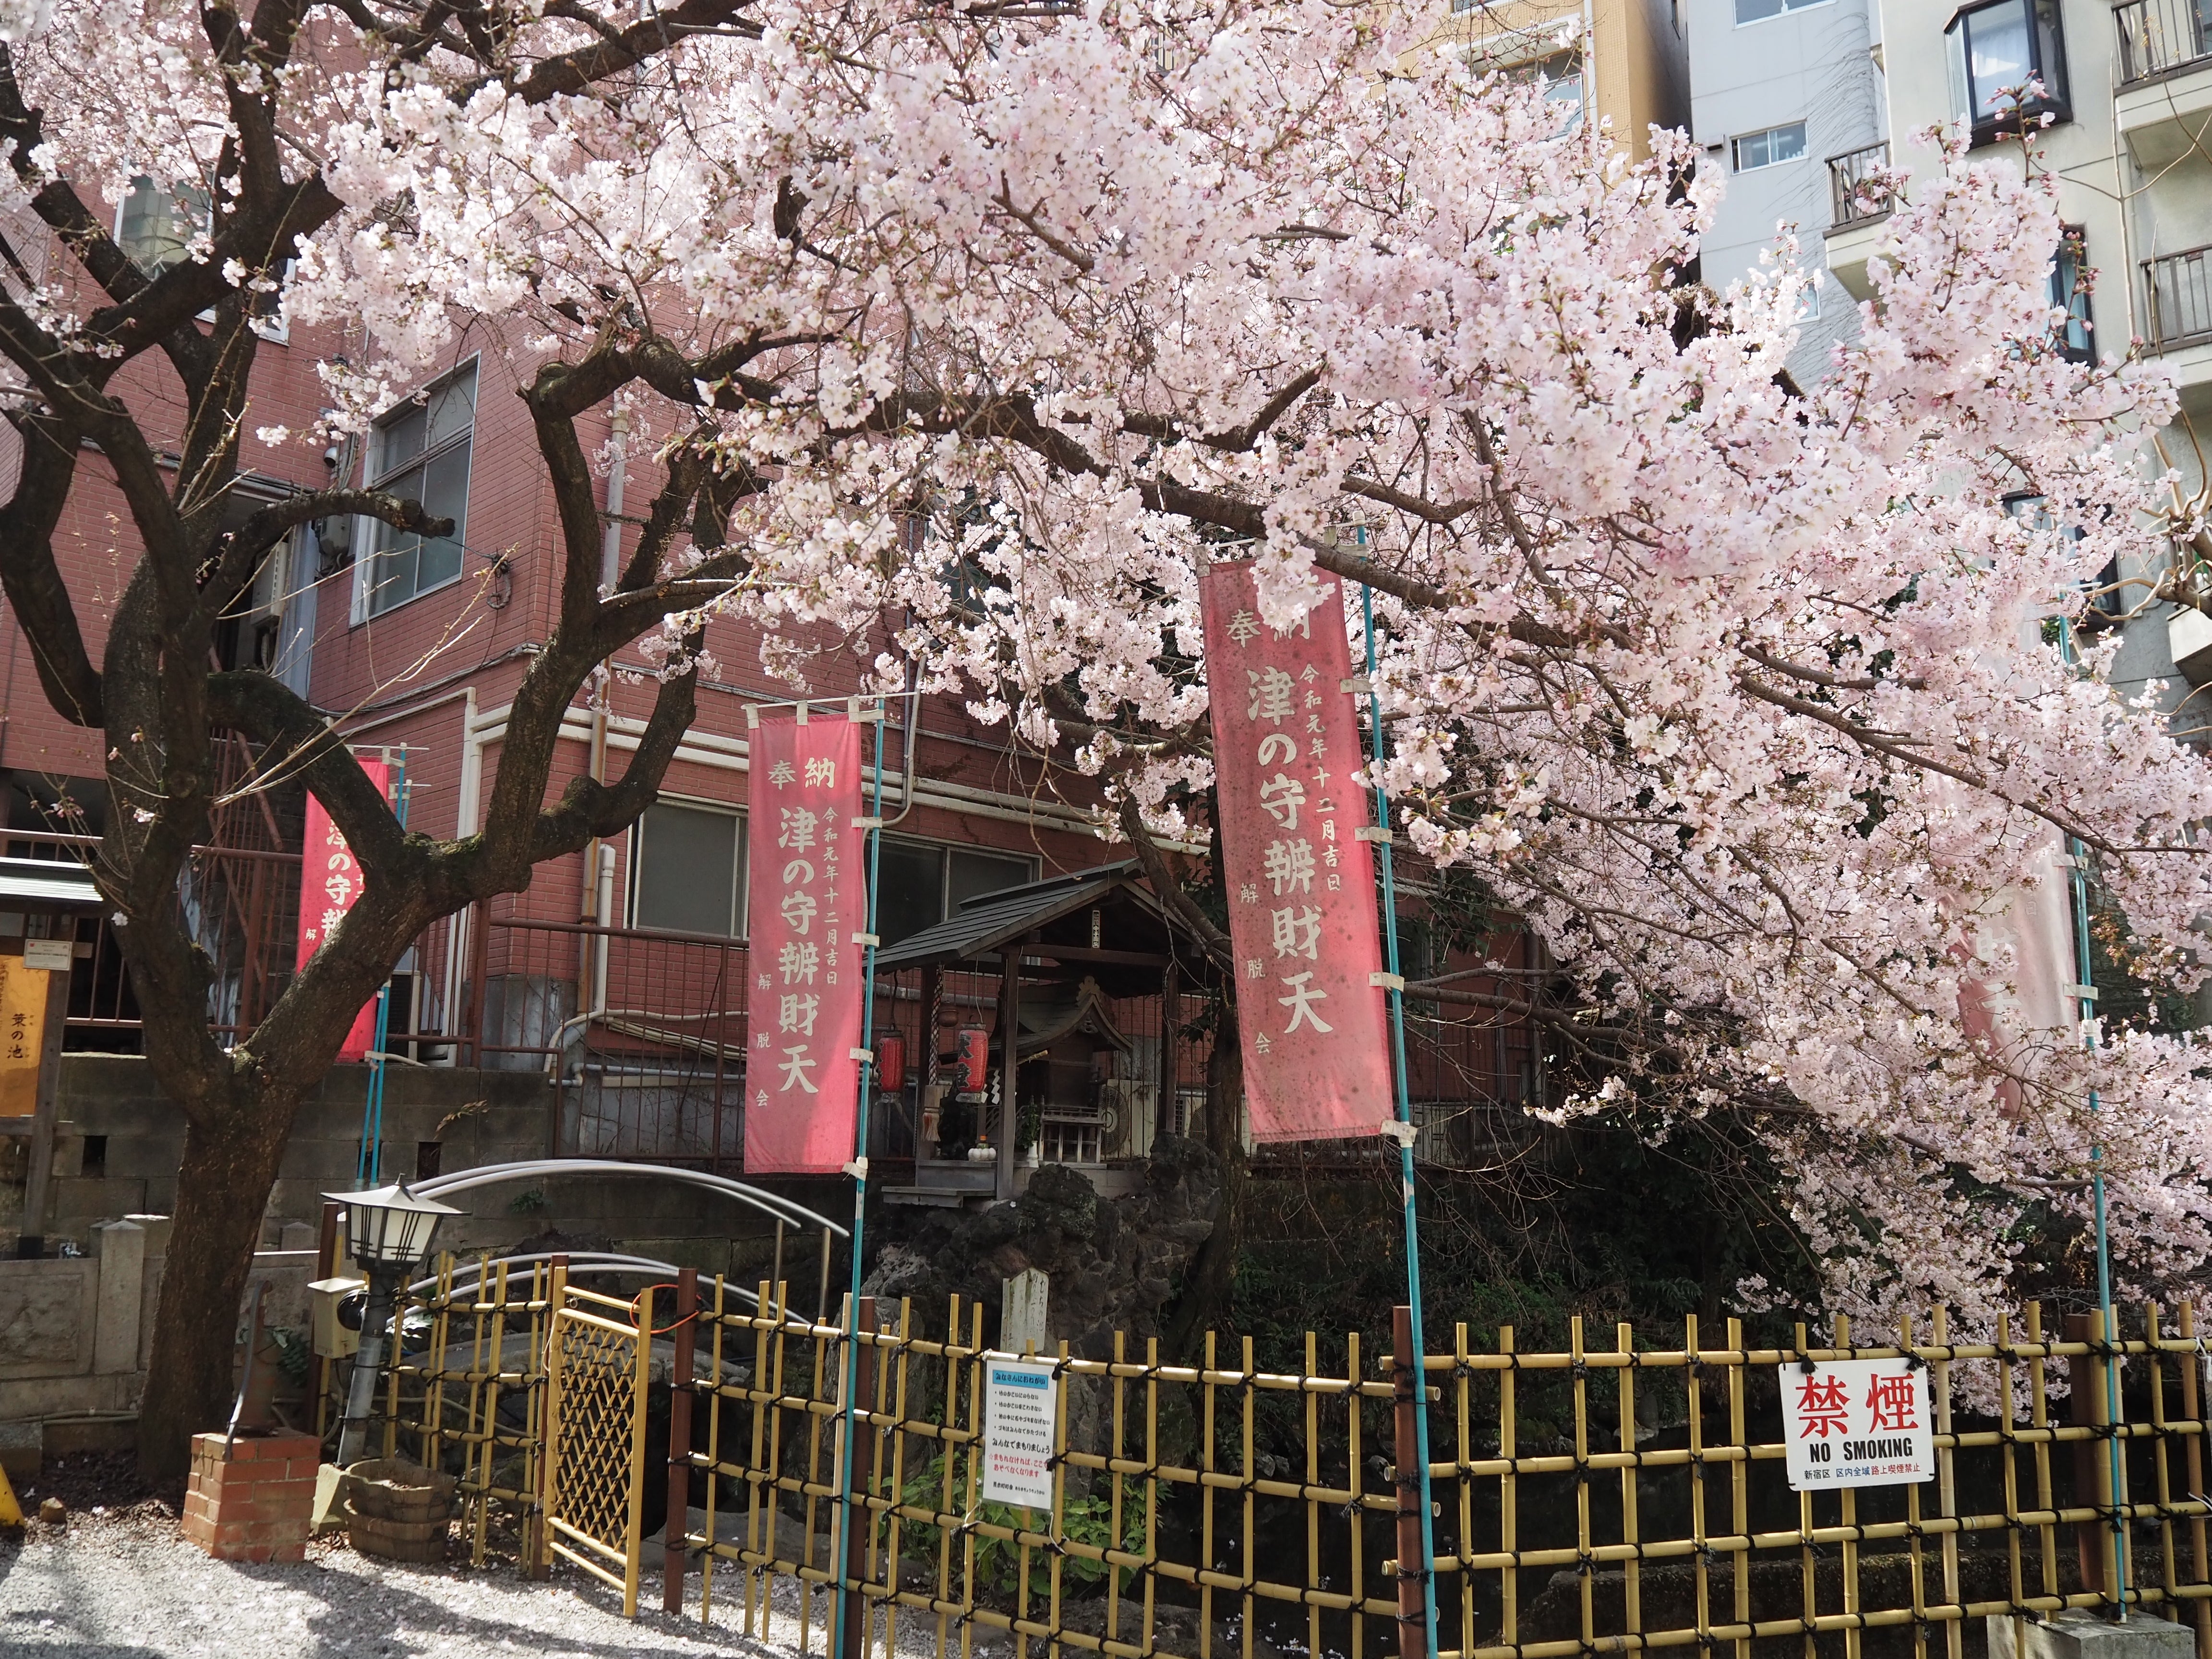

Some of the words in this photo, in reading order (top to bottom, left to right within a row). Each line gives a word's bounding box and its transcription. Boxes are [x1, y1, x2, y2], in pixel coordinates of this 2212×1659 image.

[768, 757, 835, 790] 奉納
[1299, 663, 1340, 891] 令和元年十二月吉日
[1247, 665, 1333, 1033] 津の守辨財天
[822, 806, 839, 986] 令和元年十二月吉日
[778, 806, 820, 1093] 津の守辨財天
[996, 1372, 1046, 1385] みなさんにおねがい
[1795, 1372, 1919, 1439] 禁煙
[992, 1438, 1050, 1454] みんなでまもりましょう
[1809, 1443, 1831, 1463] NO
[1843, 1437, 1913, 1461] SMOKING
[994, 1464, 1039, 1478] あそべなくなります
[1804, 1469, 1830, 1480] 新宿区
